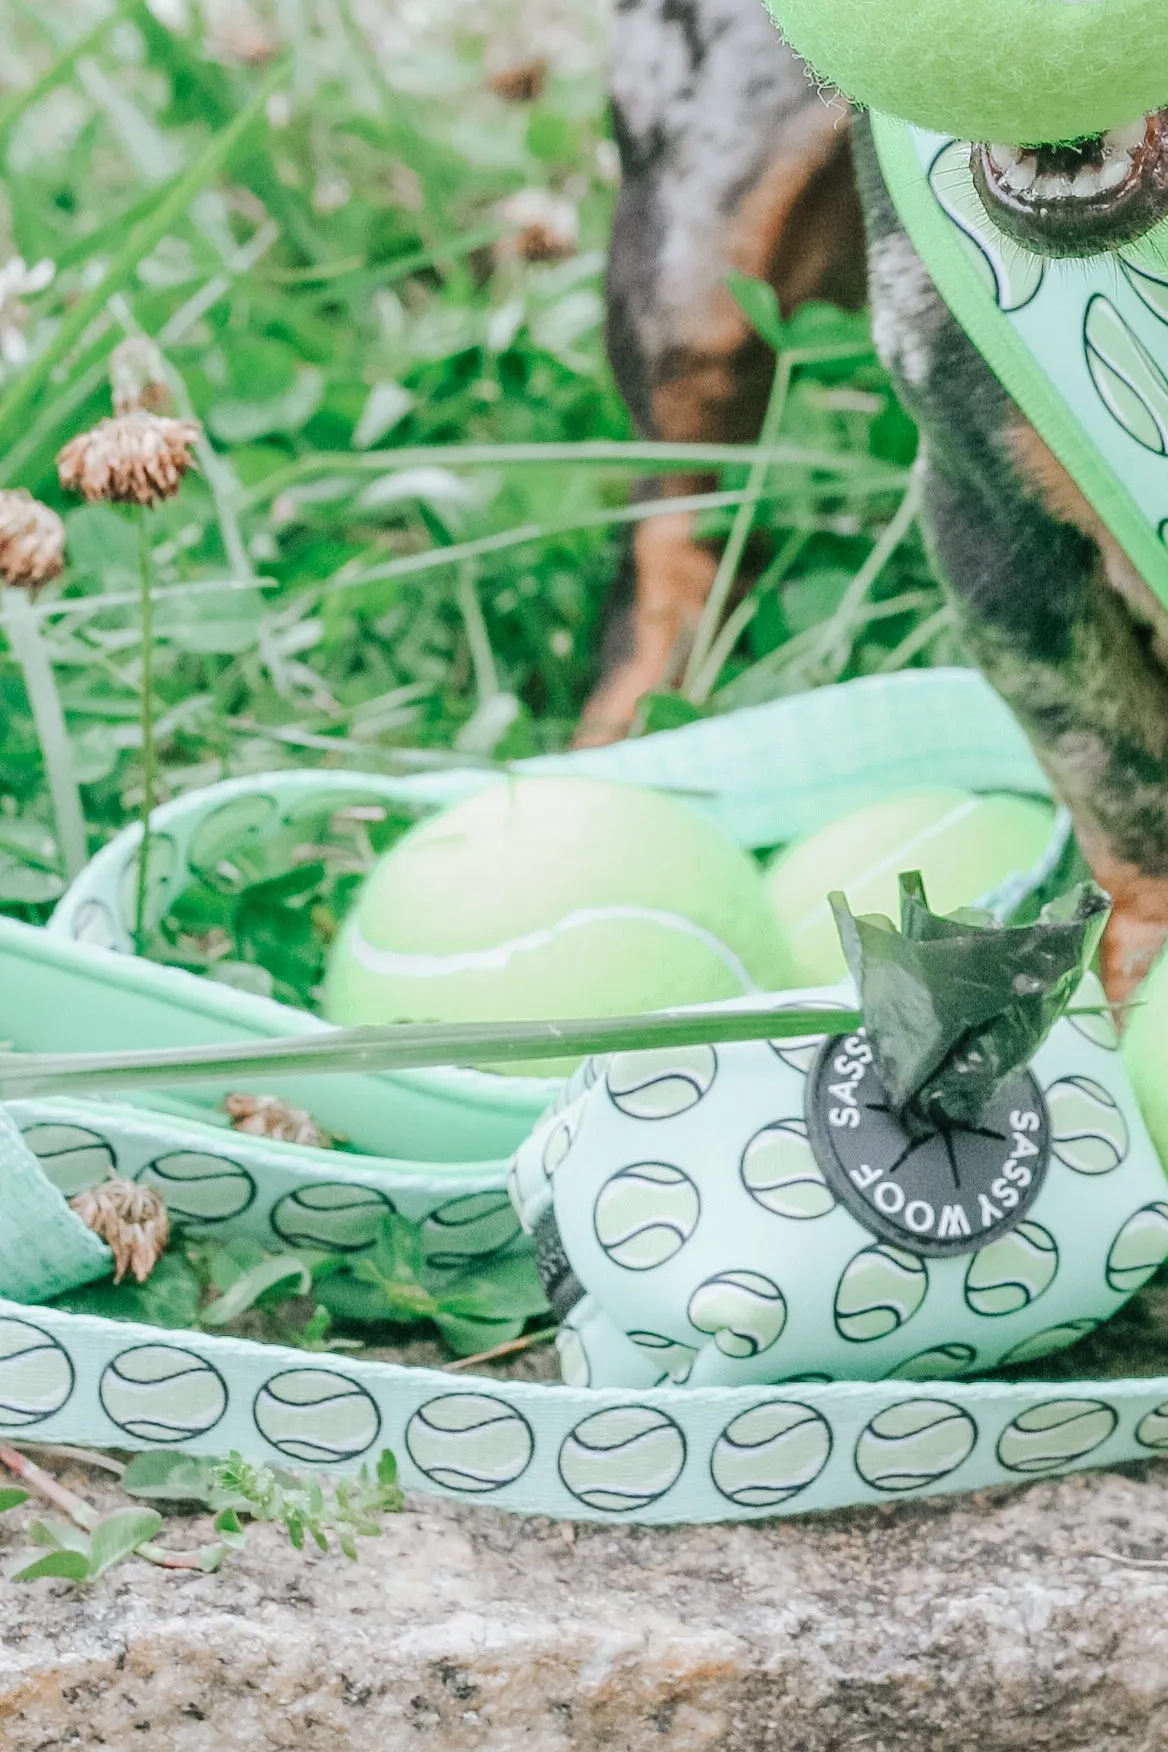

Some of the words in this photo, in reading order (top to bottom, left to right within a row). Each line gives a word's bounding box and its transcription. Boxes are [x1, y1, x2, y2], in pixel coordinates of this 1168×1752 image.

[827, 1026, 874, 1129] SASS
[850, 1163, 972, 1237] WOOF
[977, 1109, 1041, 1227] SASSY
